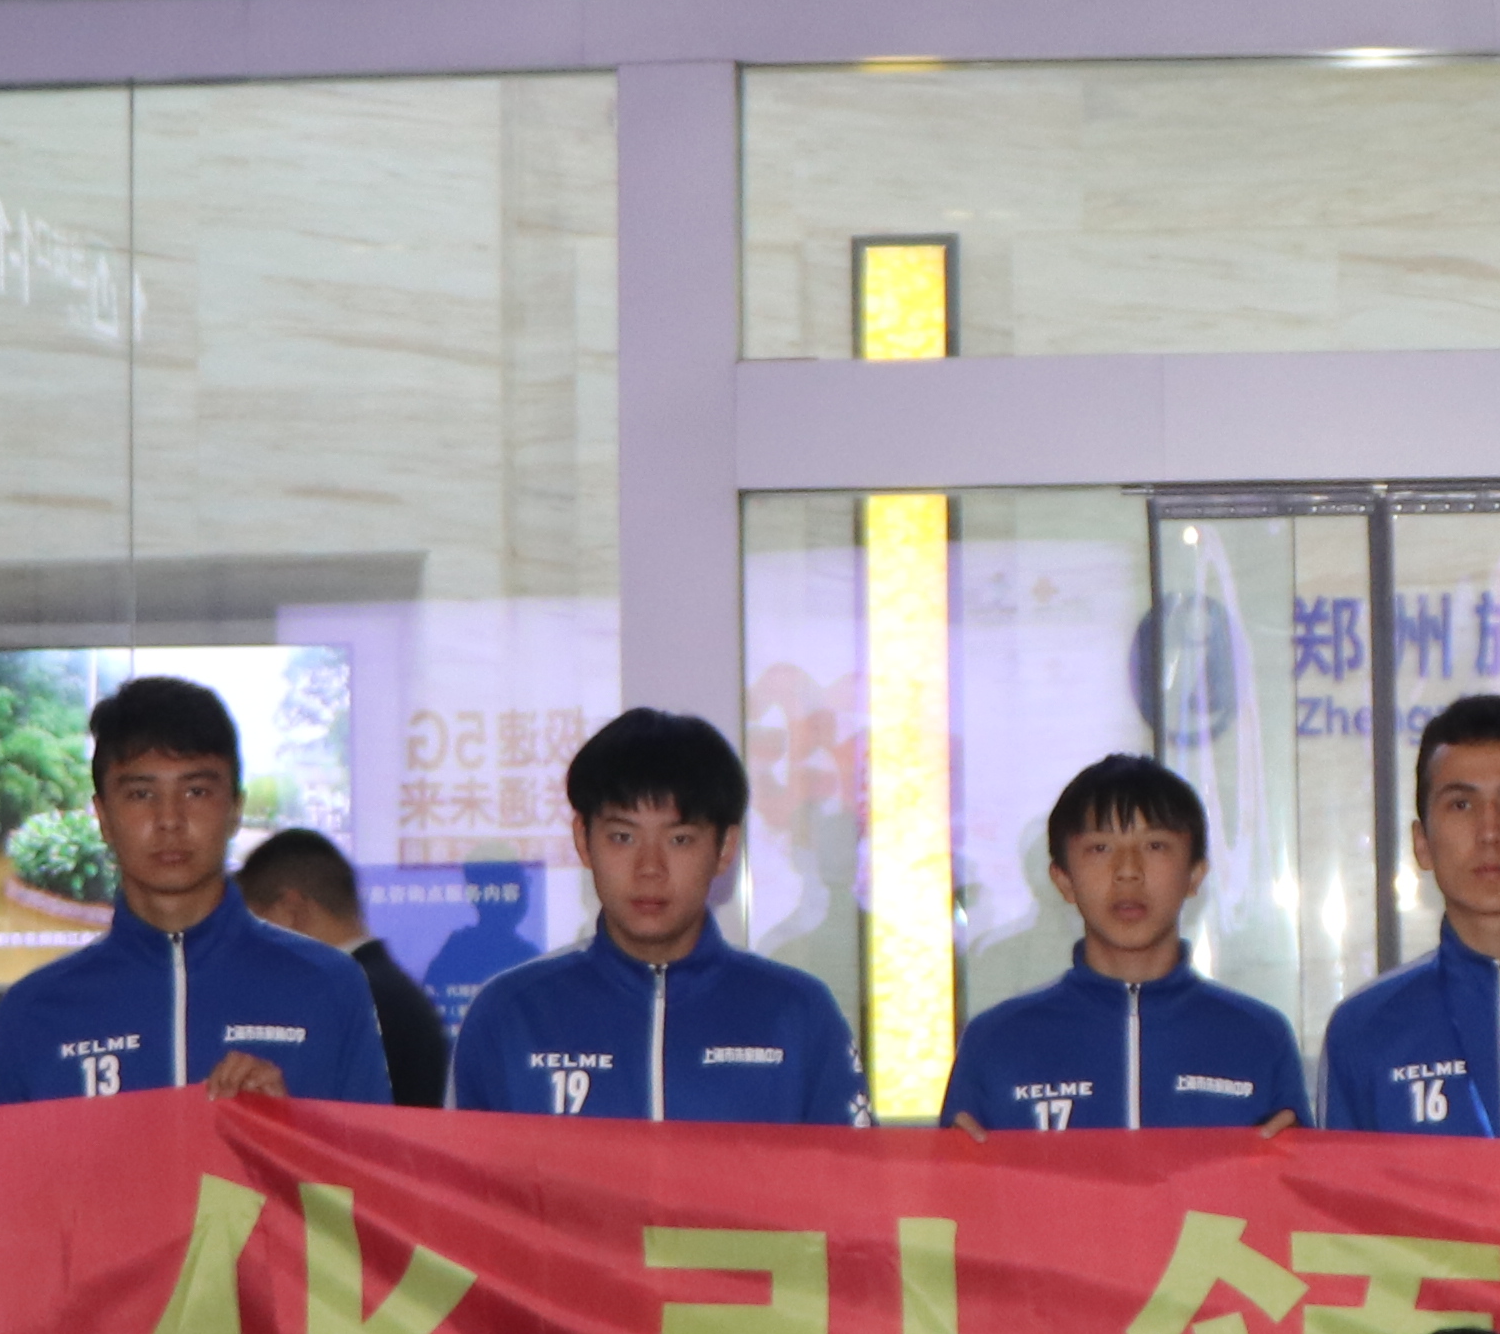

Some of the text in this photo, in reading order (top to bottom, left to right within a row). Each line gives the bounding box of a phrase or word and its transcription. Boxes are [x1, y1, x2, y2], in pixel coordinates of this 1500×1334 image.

[61, 1033, 141, 1058] KELME
[530, 1052, 614, 1068] KELME
[81, 1054, 121, 1097] 13
[1392, 1060, 1468, 1082] KELME
[551, 1070, 591, 1114] 19
[1015, 1081, 1093, 1101] KELME
[1410, 1079, 1449, 1123] 16
[1034, 1098, 1073, 1131] 17
